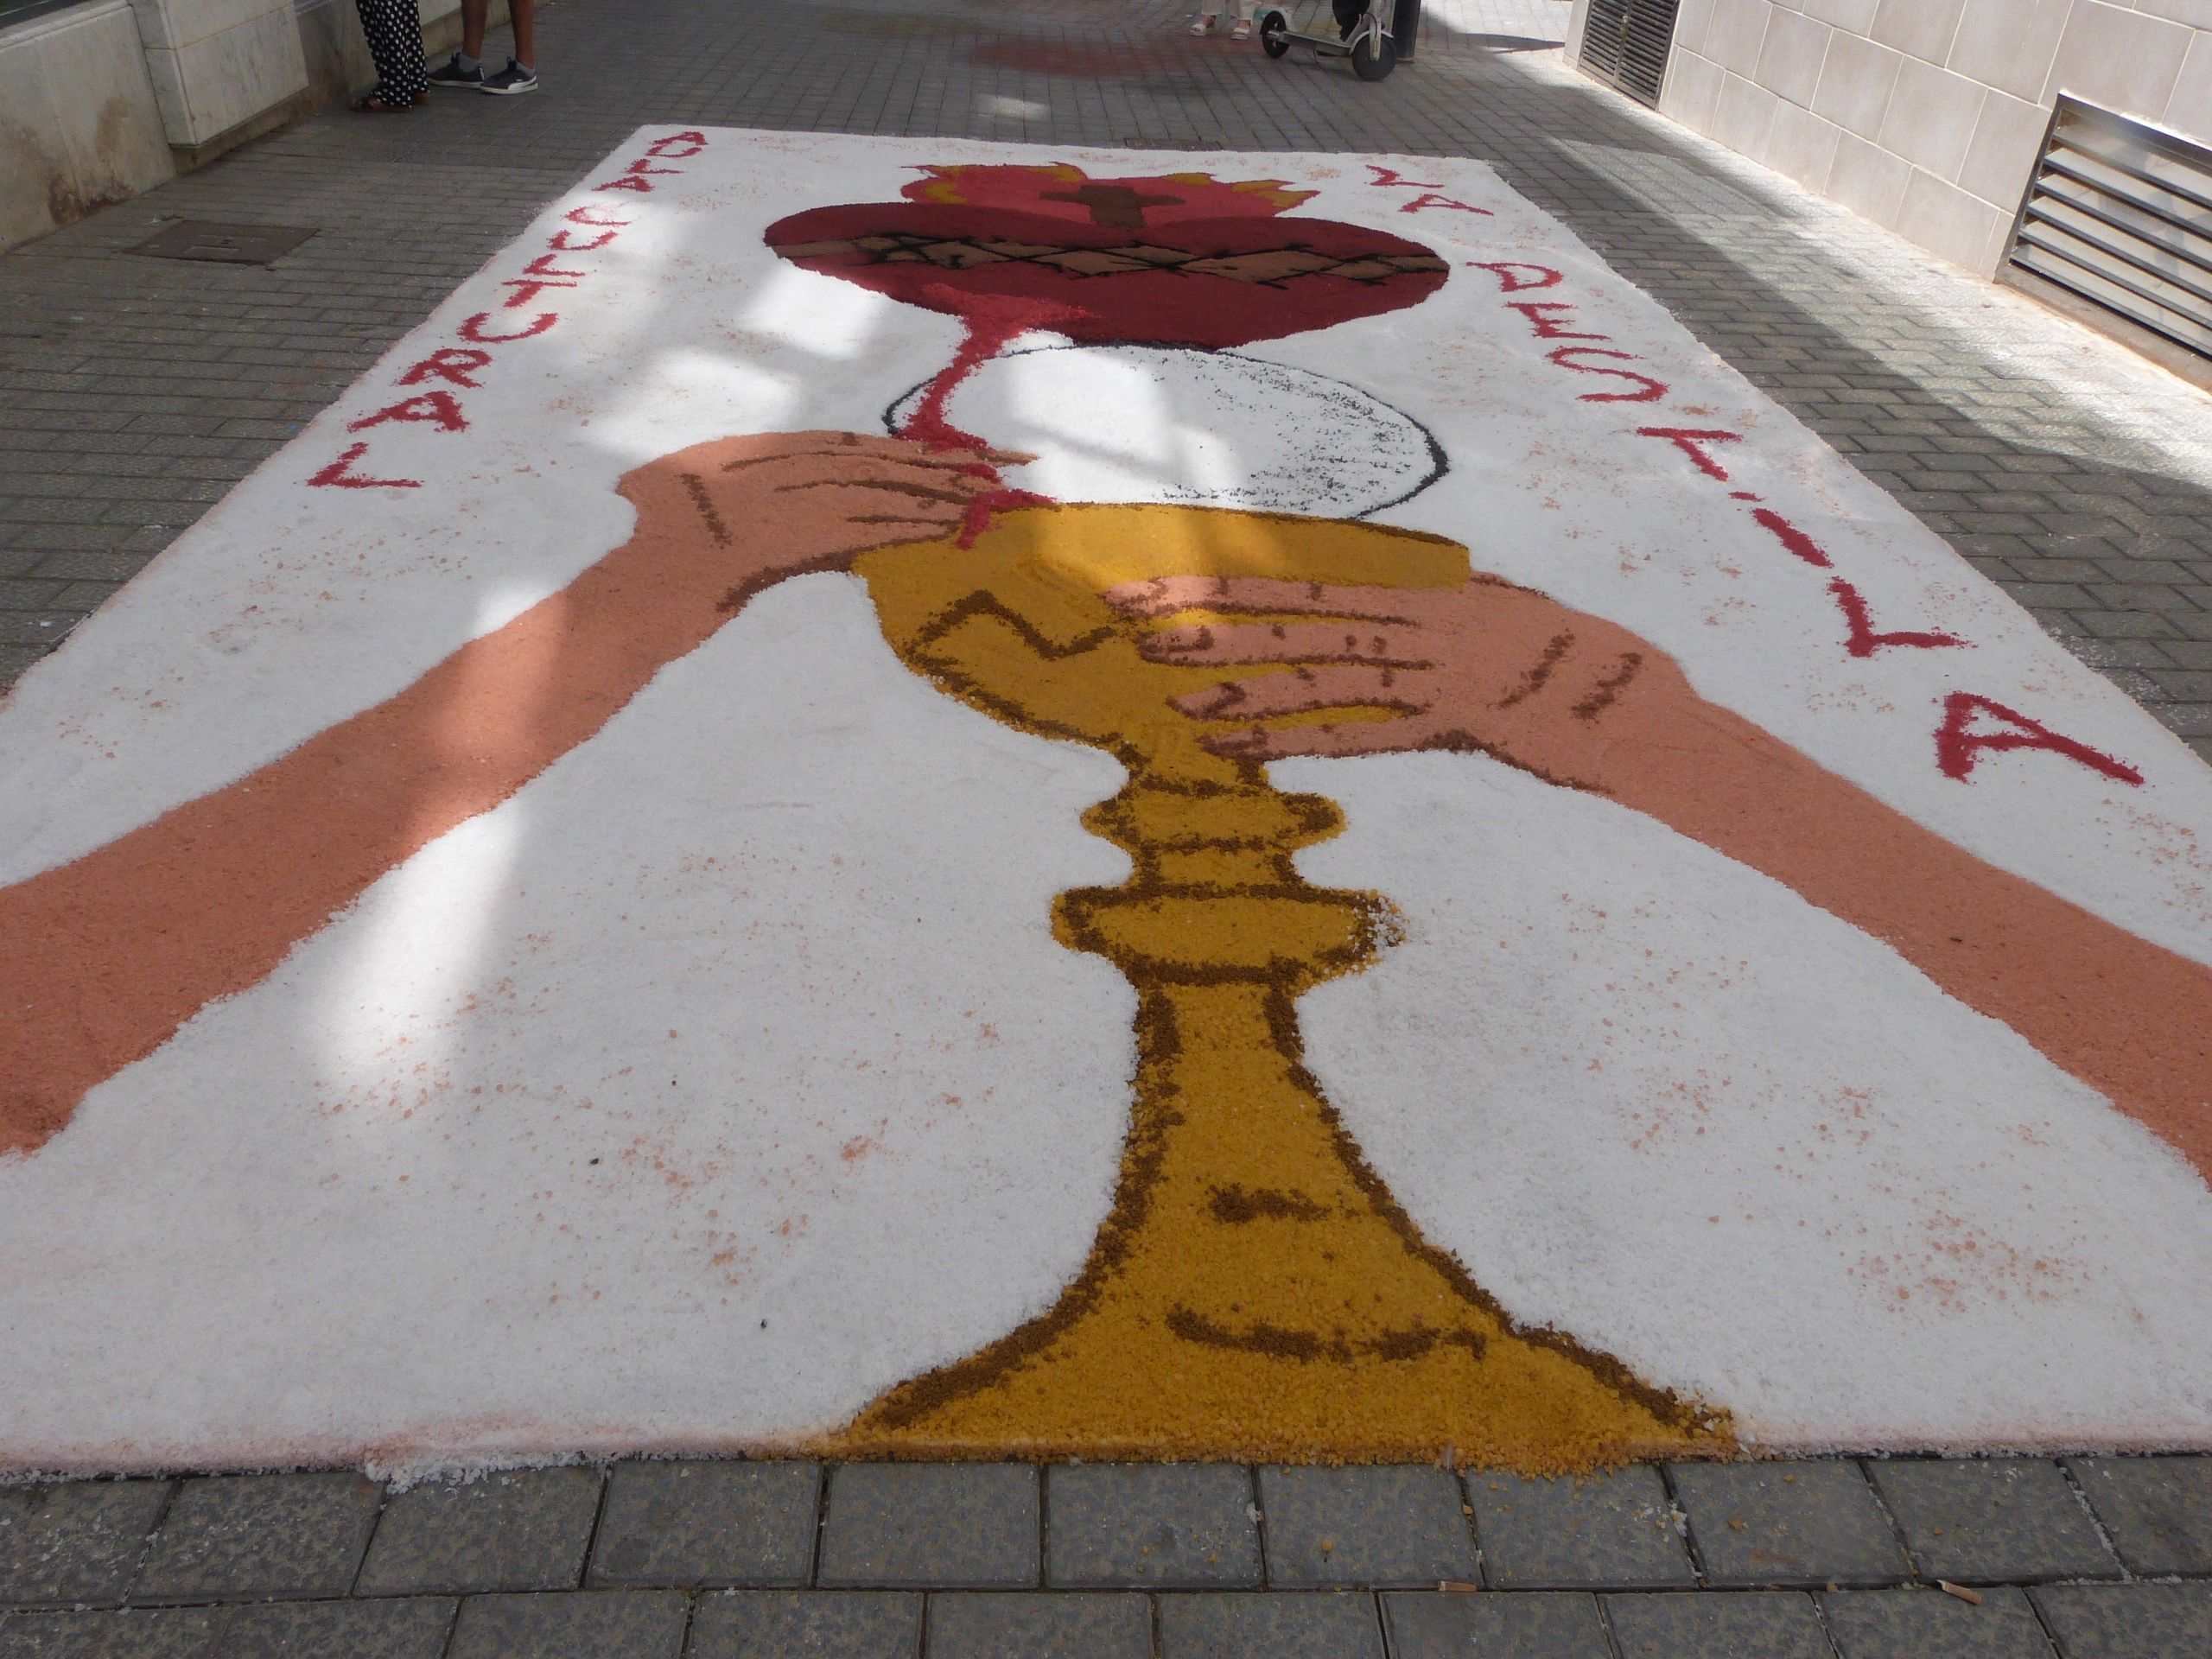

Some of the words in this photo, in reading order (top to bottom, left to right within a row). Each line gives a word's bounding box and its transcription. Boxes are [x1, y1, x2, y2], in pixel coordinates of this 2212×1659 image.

[591, 131, 709, 192] AULA
[1365, 164, 1494, 216] LA
[307, 200, 632, 488] CULTURAL
